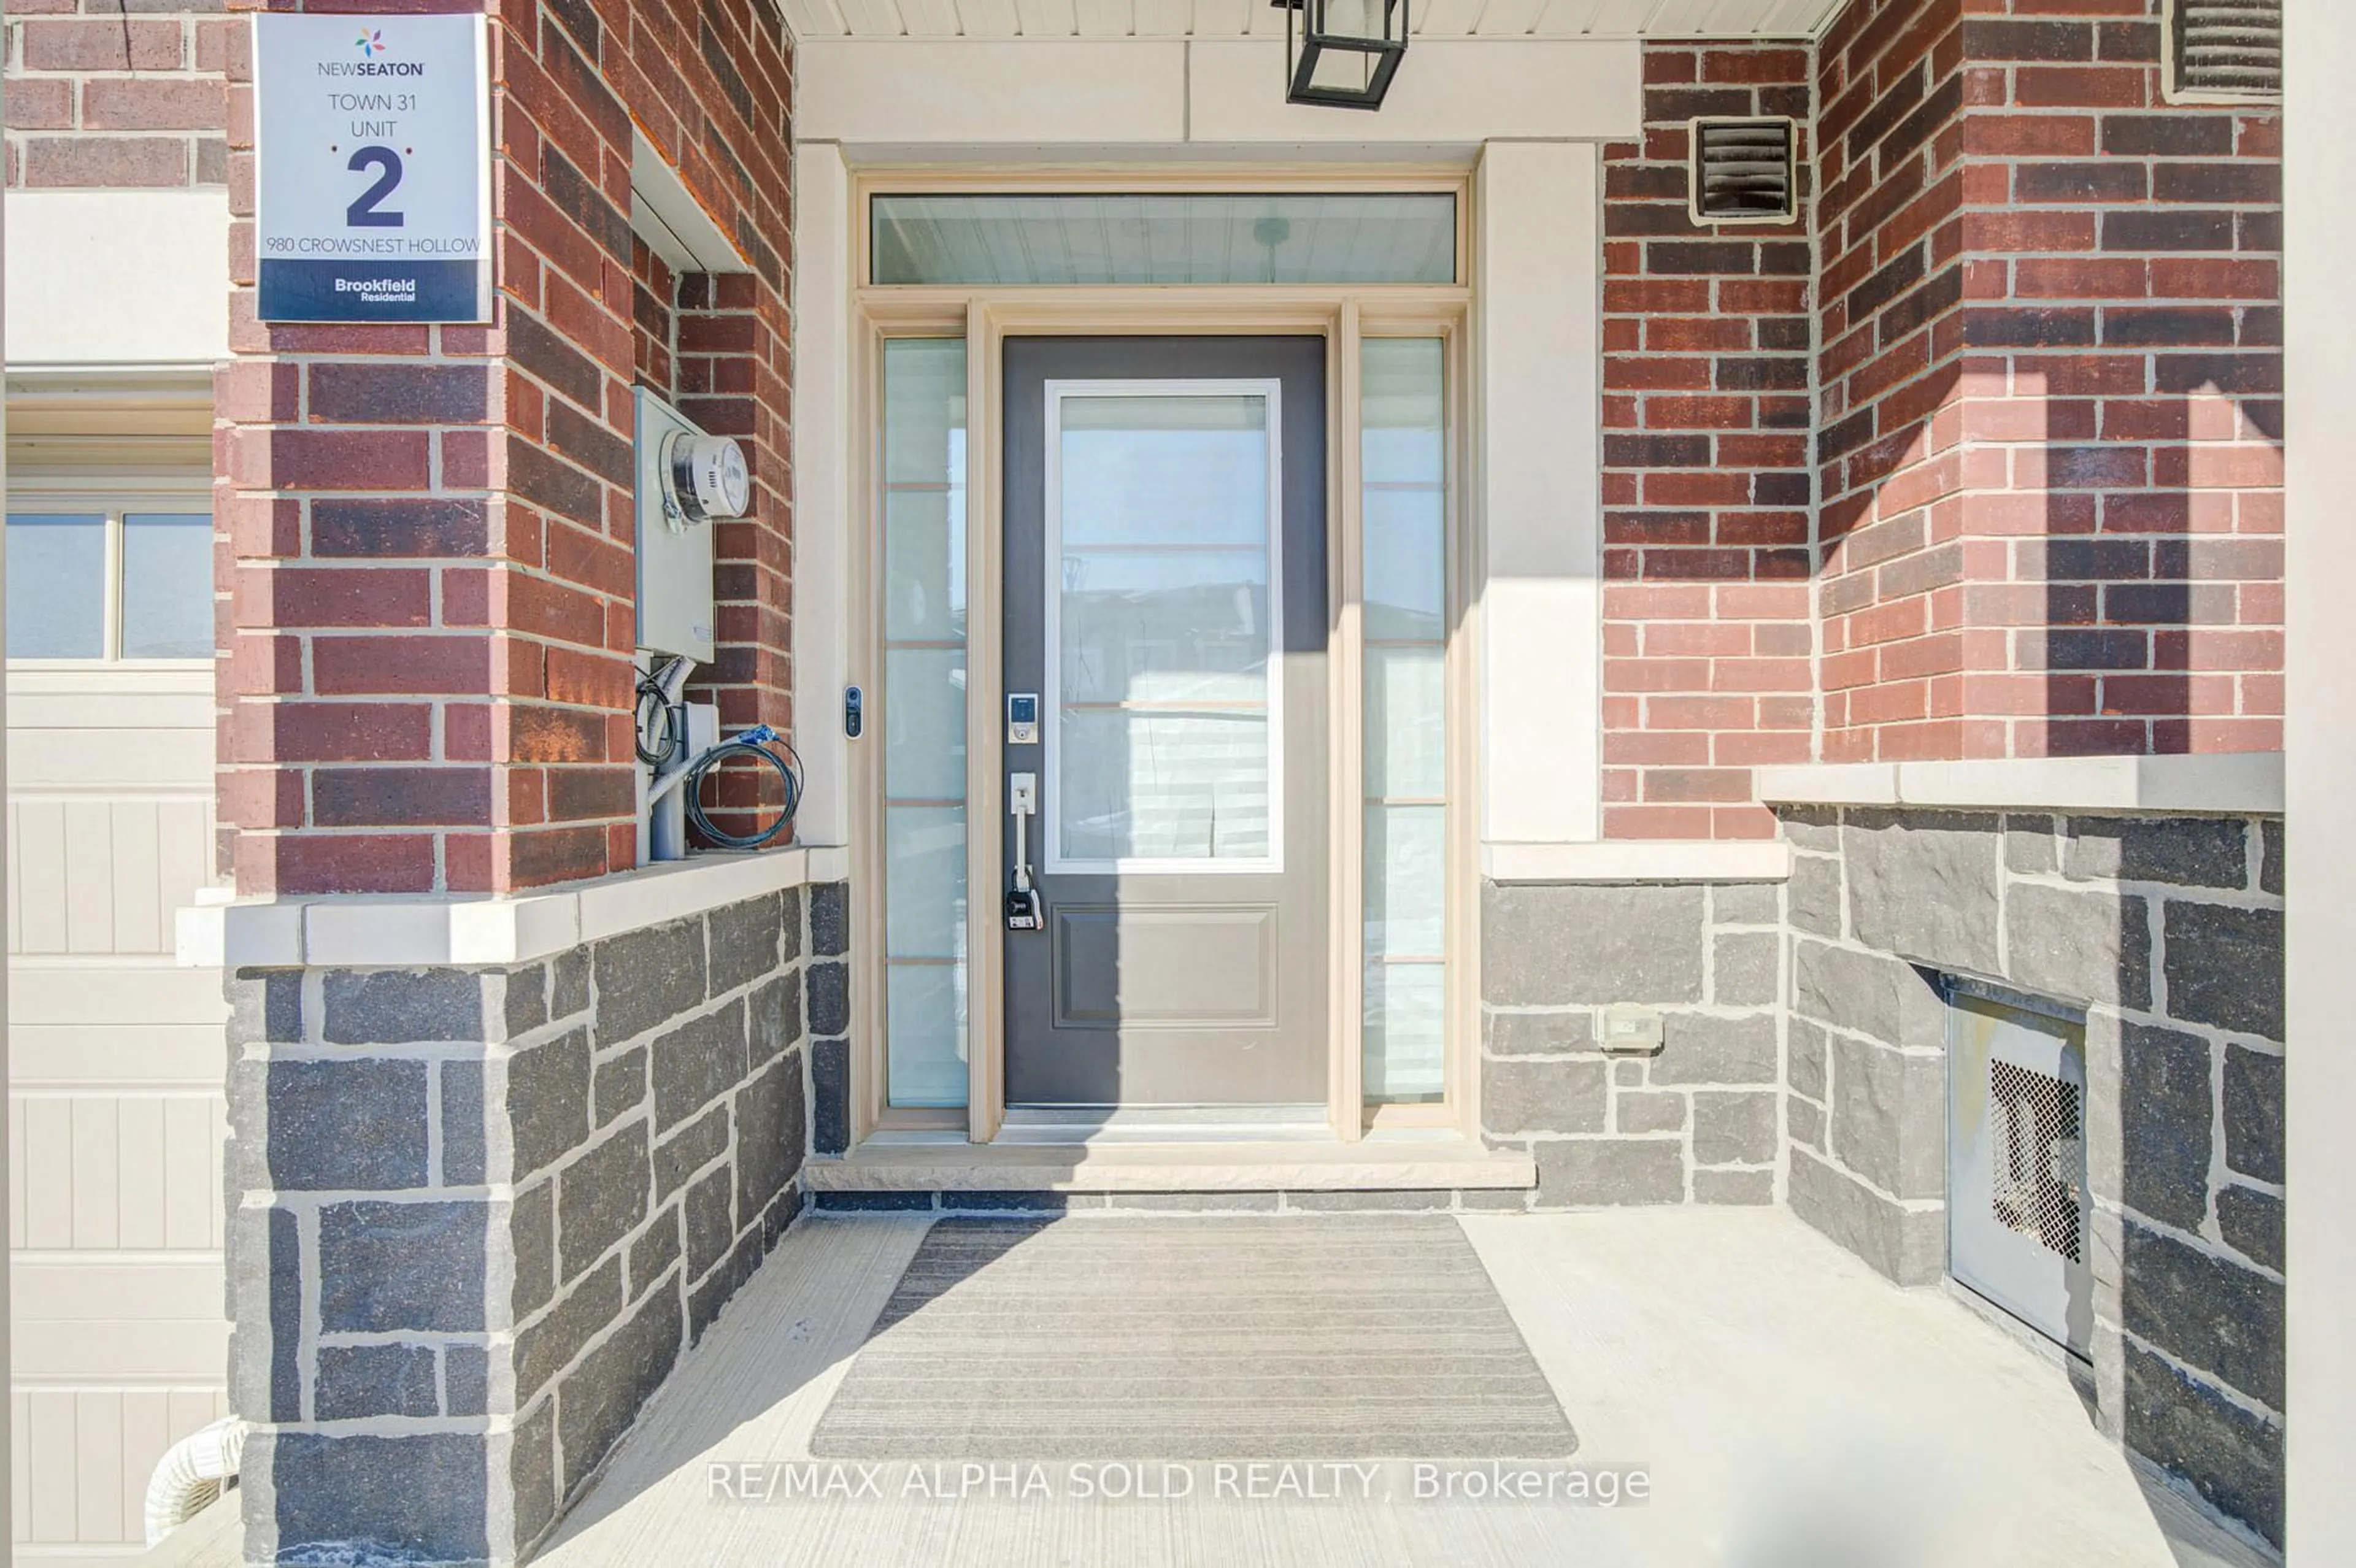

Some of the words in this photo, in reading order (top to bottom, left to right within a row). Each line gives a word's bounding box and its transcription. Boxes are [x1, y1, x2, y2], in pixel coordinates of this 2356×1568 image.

[318, 63, 423, 76] NEWSEATON
[328, 94, 391, 110] TOWN
[398, 94, 417, 110] 31
[351, 121, 398, 137] UNIT
[347, 145, 404, 226] 2
[266, 237, 294, 252] 980
[298, 238, 403, 253] CROWSNEST
[409, 239, 481, 253] HOLLOW
[335, 279, 415, 292] Brookfield
[361, 293, 415, 302] Residential
